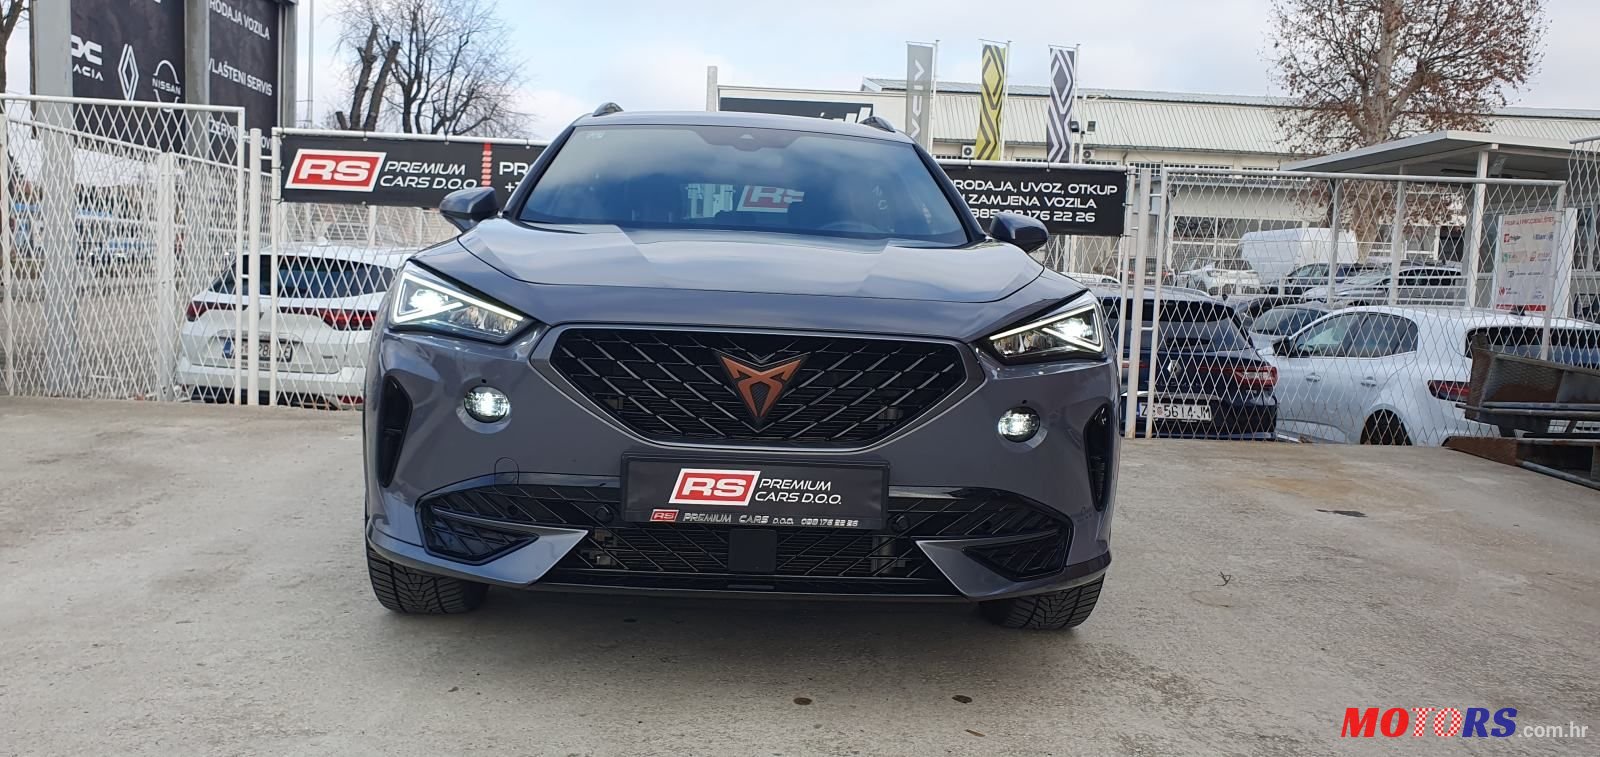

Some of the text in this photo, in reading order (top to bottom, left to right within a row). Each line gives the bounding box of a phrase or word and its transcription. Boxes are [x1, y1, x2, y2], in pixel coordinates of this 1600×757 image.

[210, 0, 271, 40] RODAJA VOZILA
[73, 63, 104, 81] ACIA
[152, 78, 181, 95] NISSAN
[247, 74, 273, 96] SERVIS
[298, 158, 371, 182] RS
[384, 161, 466, 175] PREMIUM
[499, 161, 531, 176] PR
[380, 175, 477, 190] CARS D.O.O
[953, 179, 1118, 195] RODAJA, UVOZ, OTKUP
[968, 194, 1040, 206] ZAMJENA
[1044, 196, 1097, 209] VOZILA
[1053, 211, 1073, 222] 22
[1075, 211, 1096, 223] 26
[681, 477, 747, 497] RS
[759, 478, 831, 491] PREMIUM
[755, 491, 842, 505] CARS D.O.O.
[653, 512, 674, 520] RS
[683, 512, 732, 523] PREMIUM
[739, 514, 769, 524] CARS
